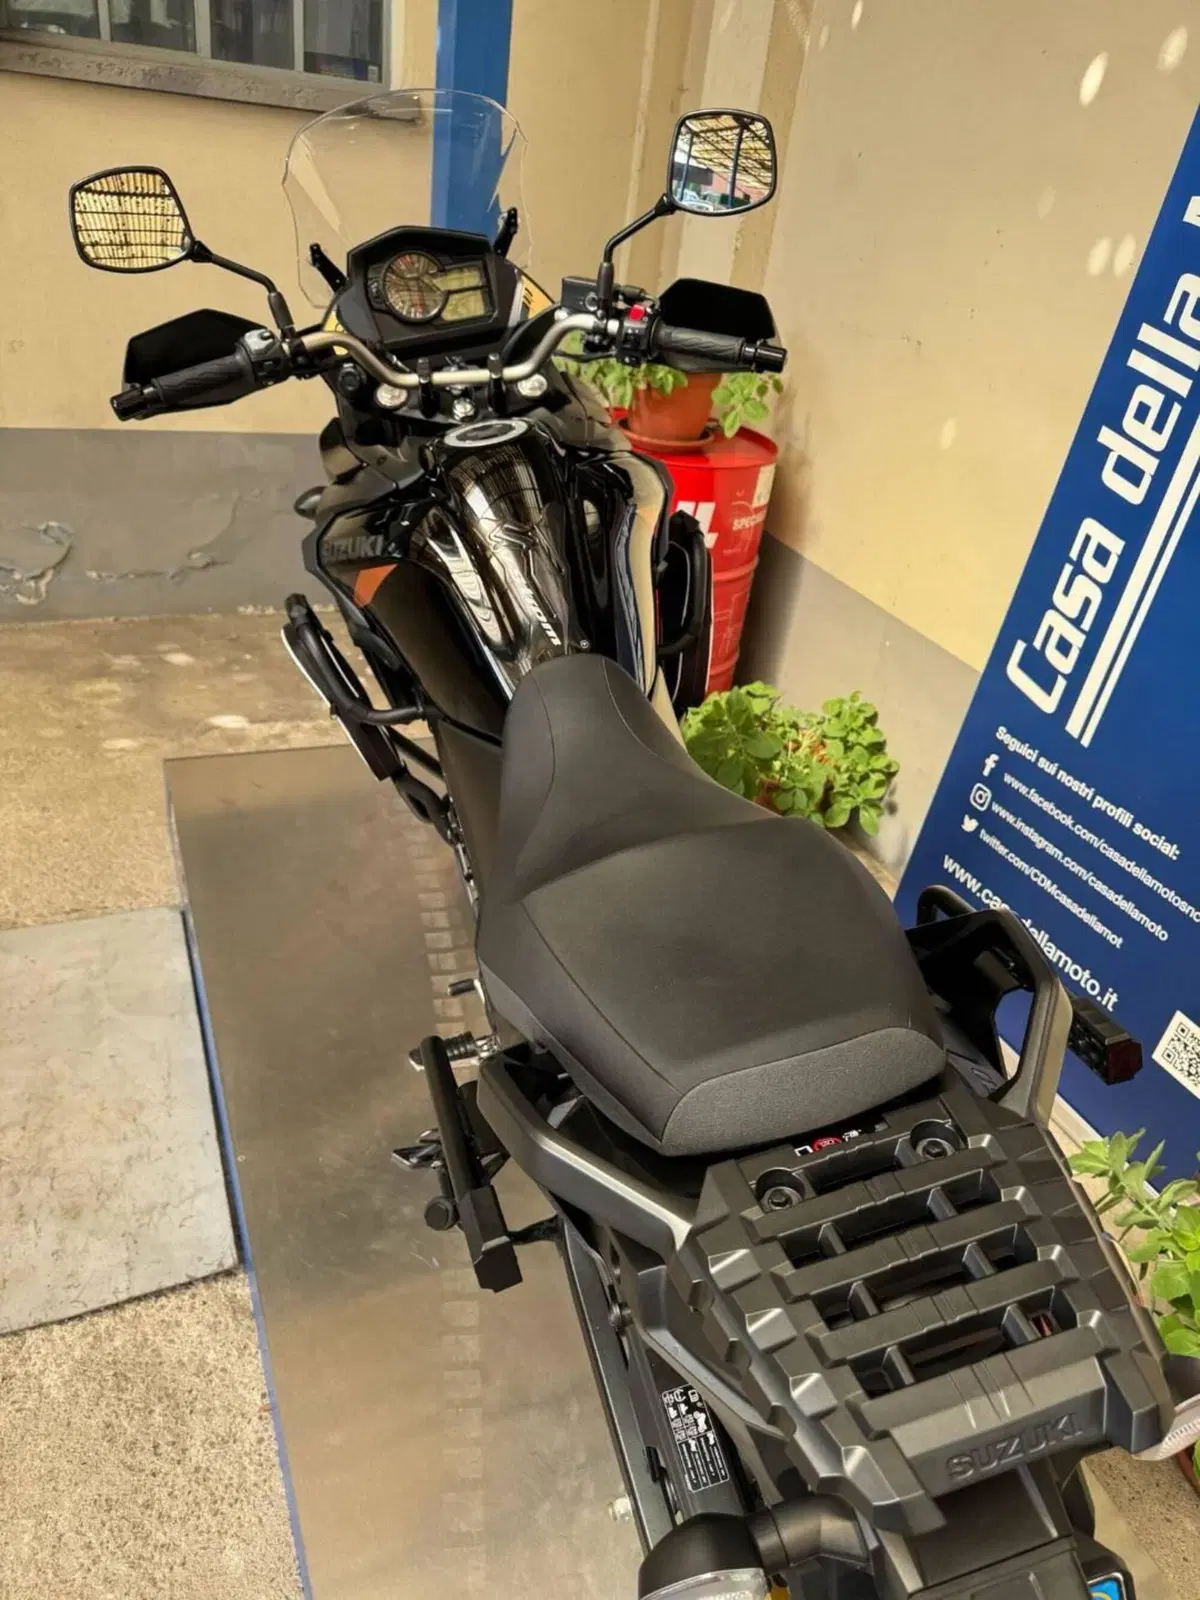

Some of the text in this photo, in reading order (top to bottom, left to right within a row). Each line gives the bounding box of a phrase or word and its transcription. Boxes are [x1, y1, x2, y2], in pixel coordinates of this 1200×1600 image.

[1006, 272, 1200, 714] Casa della
[995, 726, 1181, 861] Seguici sui nostri profili social:
[979, 828, 1124, 949] twitter.com/CDMcasadellamot
[991, 801, 1169, 942] www.instagram.com/casadellamoto
[946, 1413, 1084, 1480] SUZUKI
